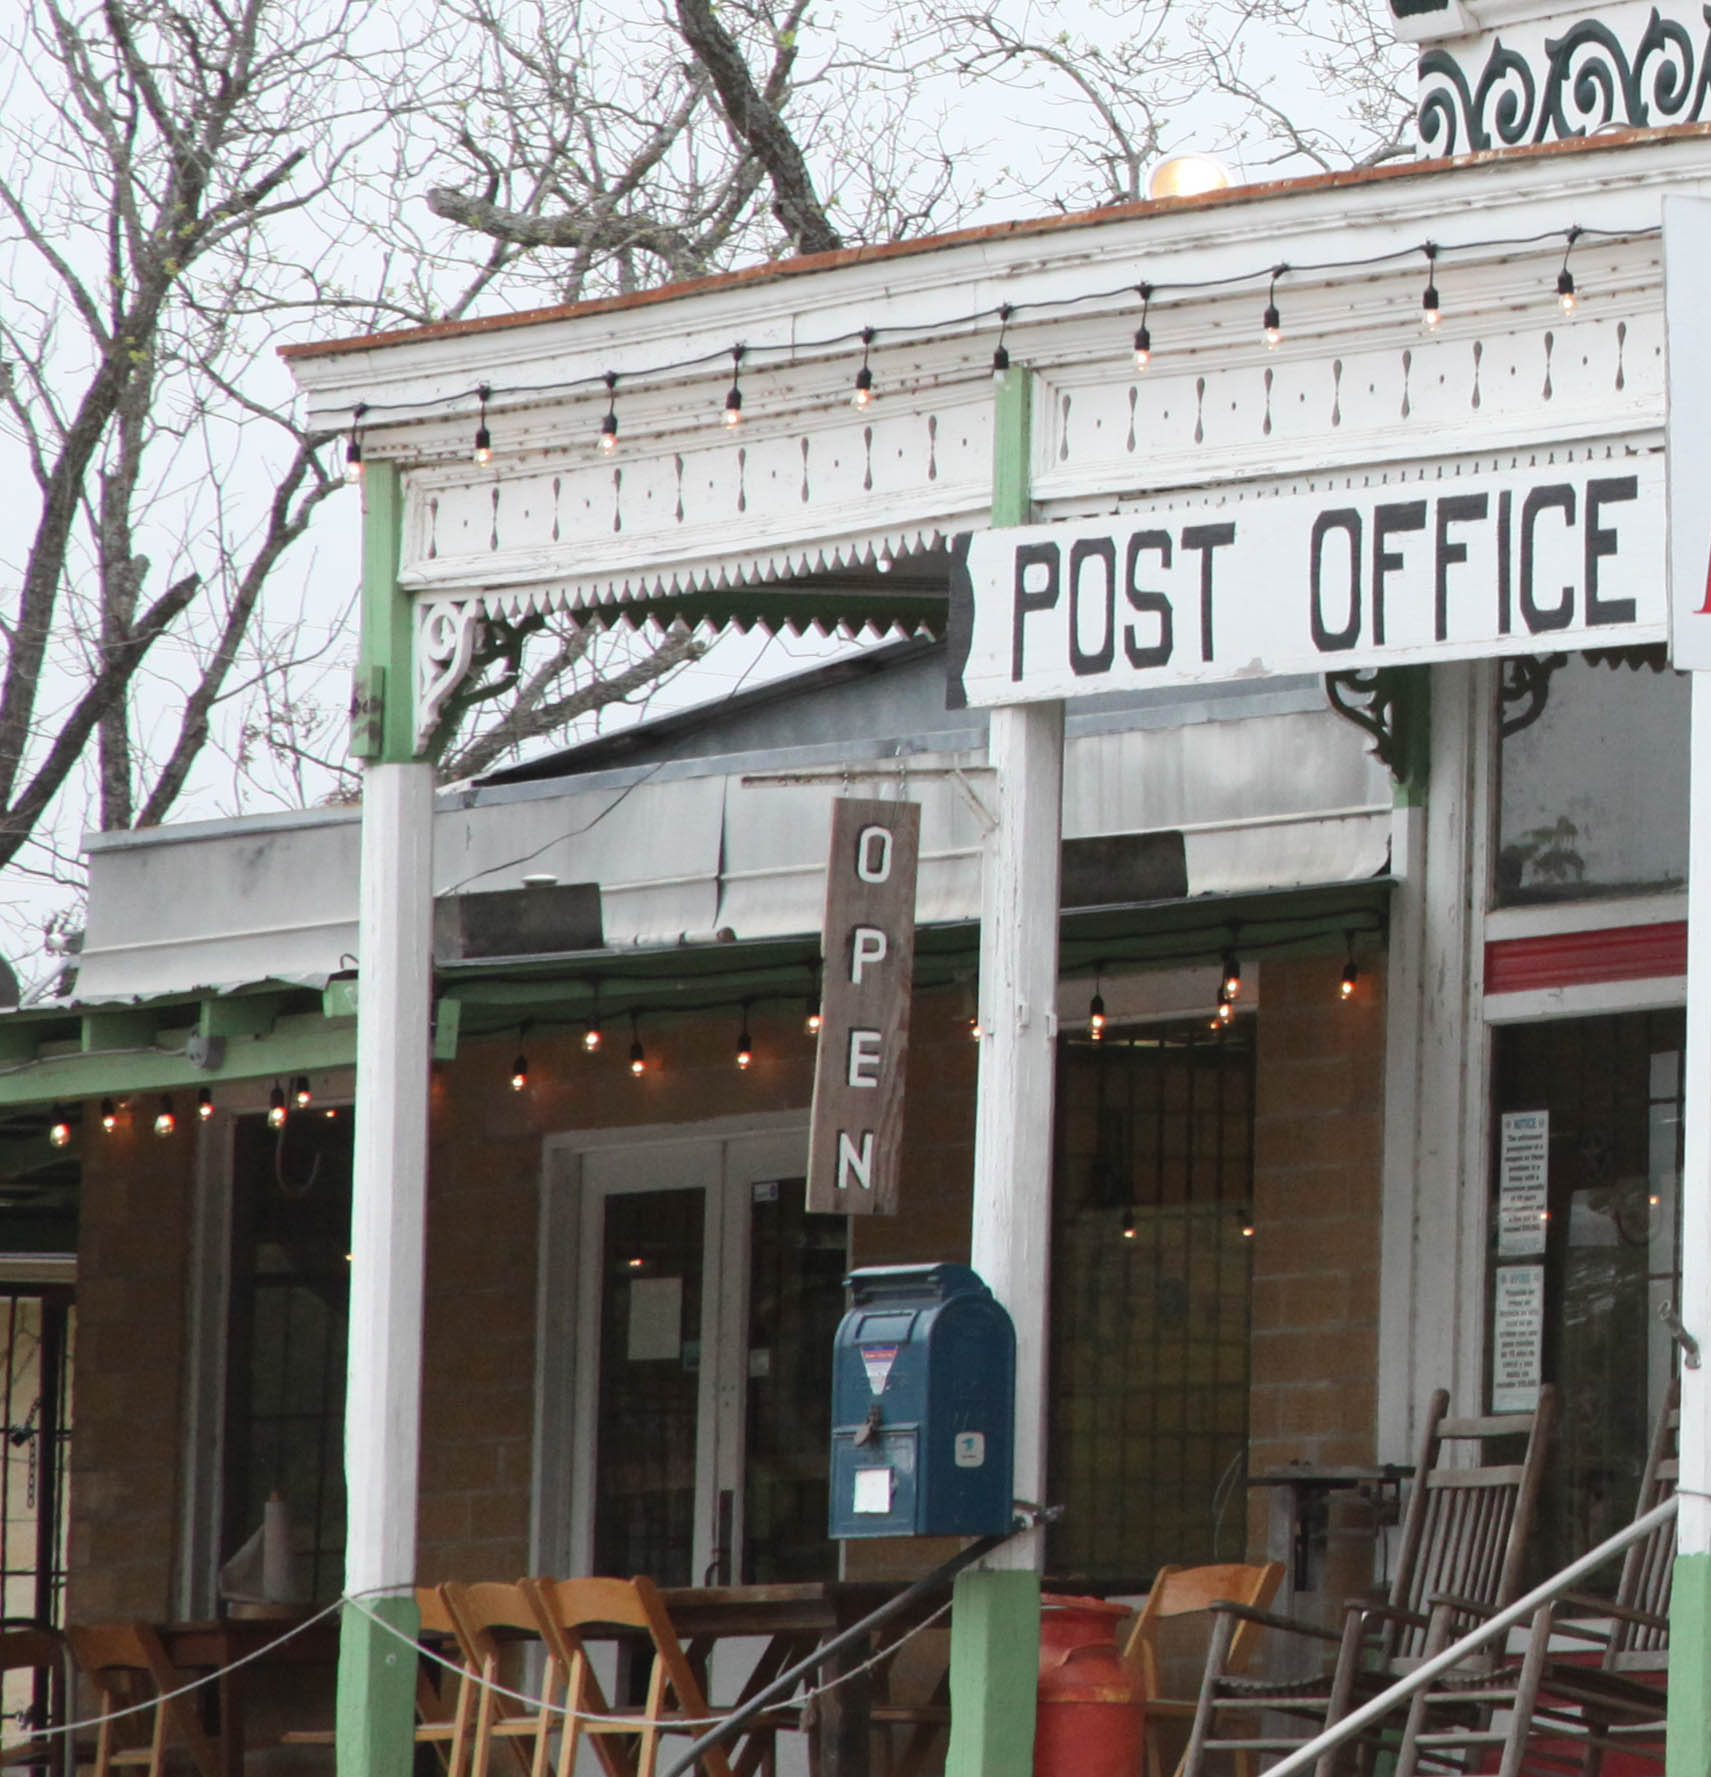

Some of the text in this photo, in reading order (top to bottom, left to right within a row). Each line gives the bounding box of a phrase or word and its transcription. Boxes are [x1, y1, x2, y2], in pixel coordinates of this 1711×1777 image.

[1012, 475, 1638, 682] POST OFFICE
[836, 825, 893, 1190] OPEN
